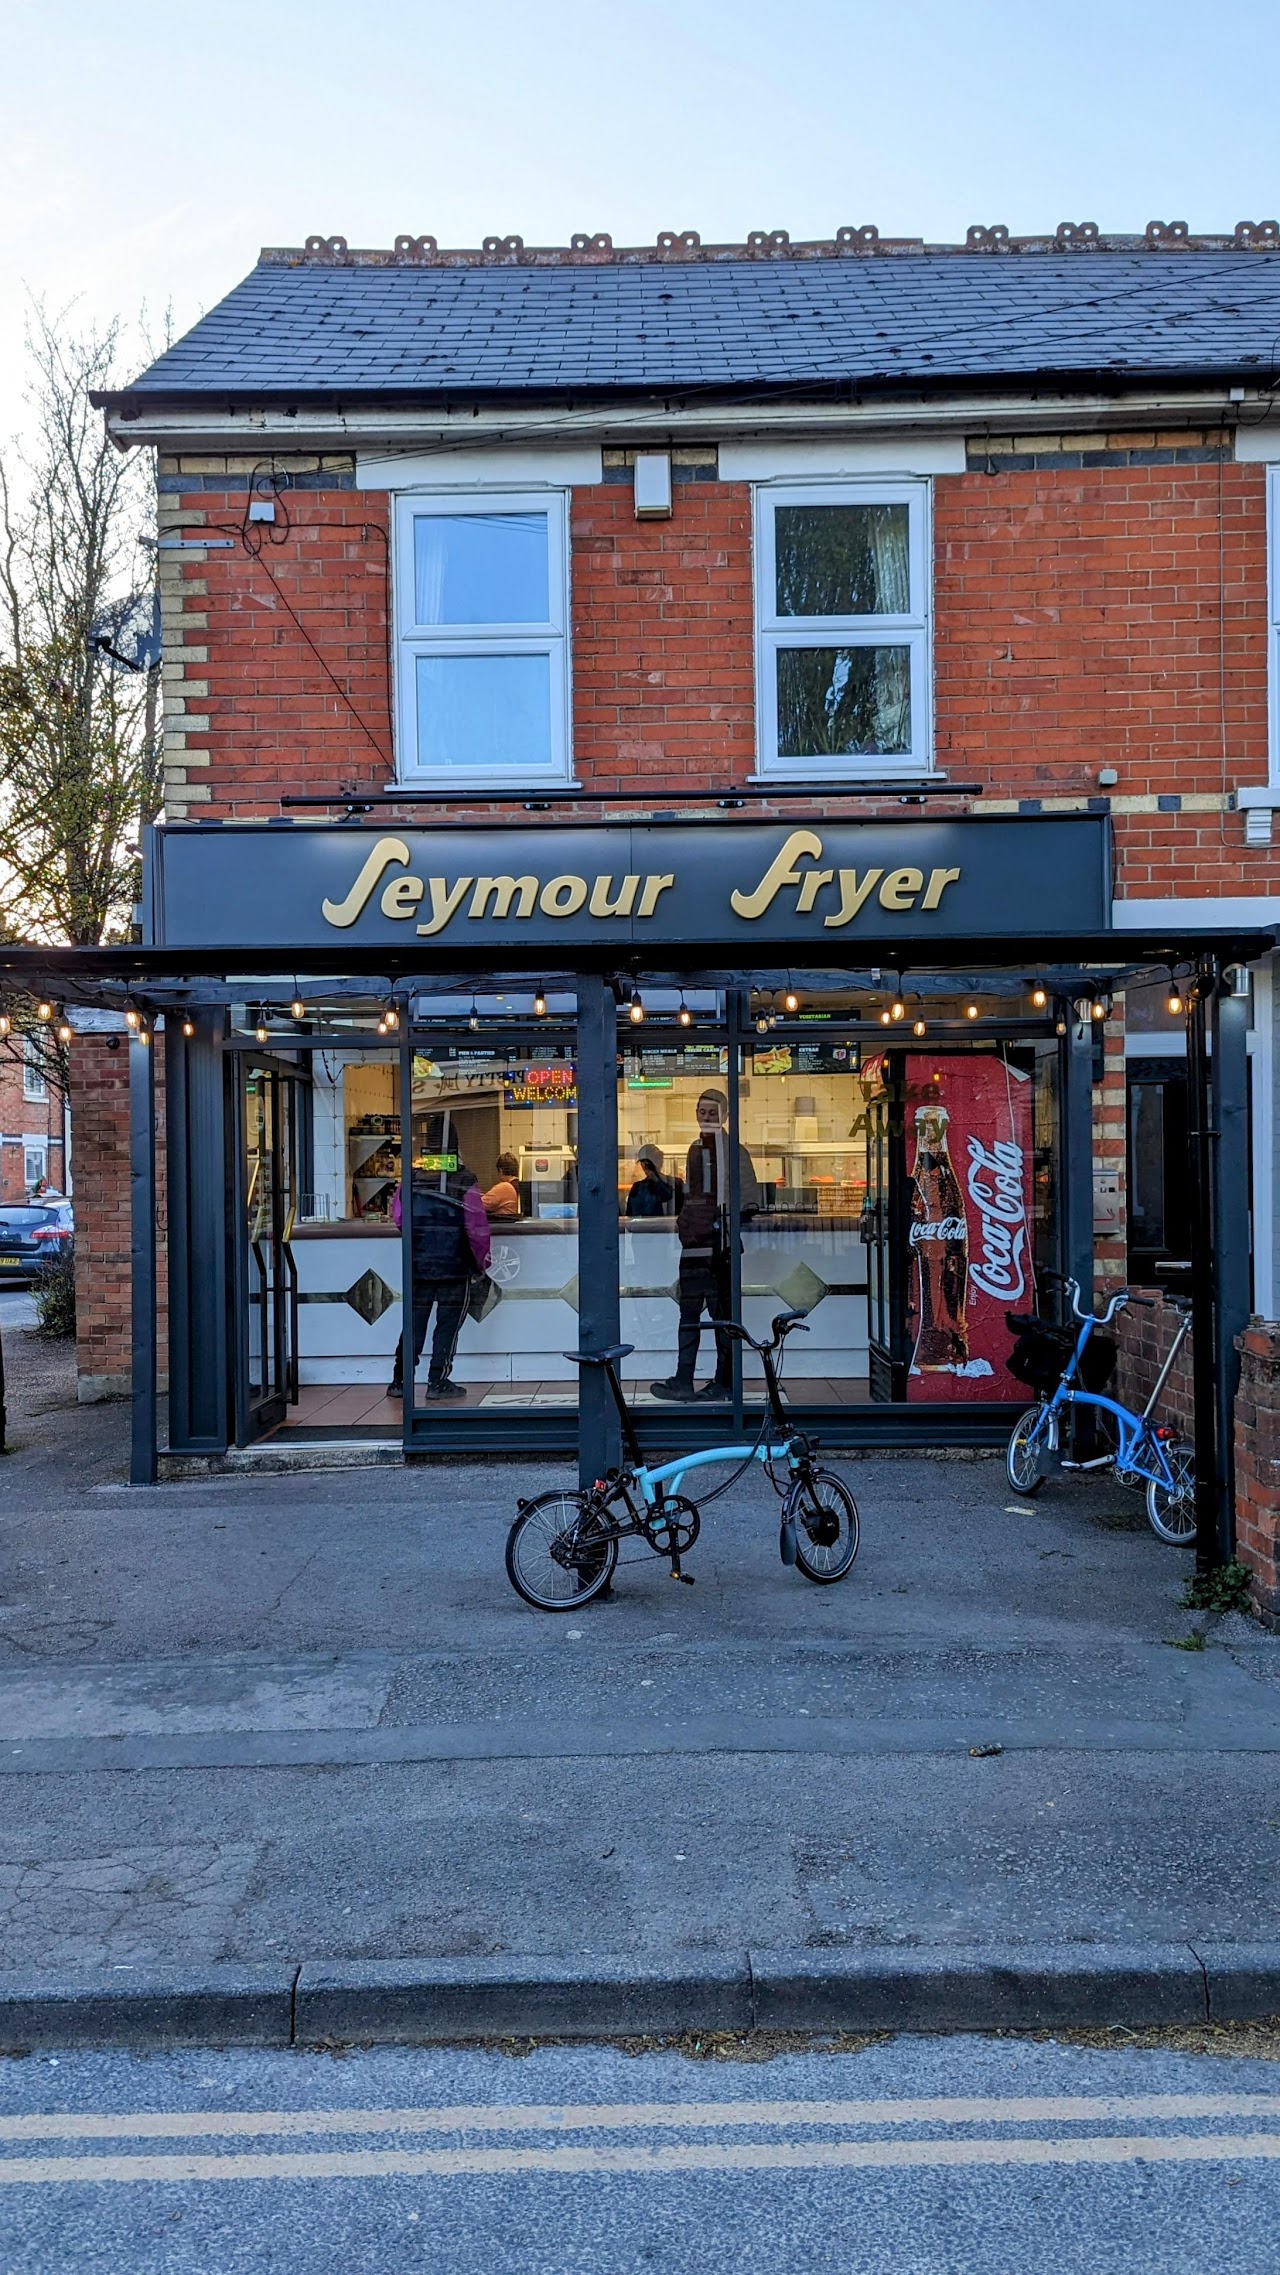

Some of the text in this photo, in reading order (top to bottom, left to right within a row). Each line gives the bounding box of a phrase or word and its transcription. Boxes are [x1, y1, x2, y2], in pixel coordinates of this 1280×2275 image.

[322, 830, 961, 936] Seymour Fryer
[527, 1070, 573, 1084] OPEN
[512, 1086, 578, 1101] WELCOM
[857, 1081, 940, 1103] Take
[848, 1114, 950, 1144] Away
[968, 1134, 1026, 1300] Coca-Cola
[968, 1284, 977, 1306] Enjoy
